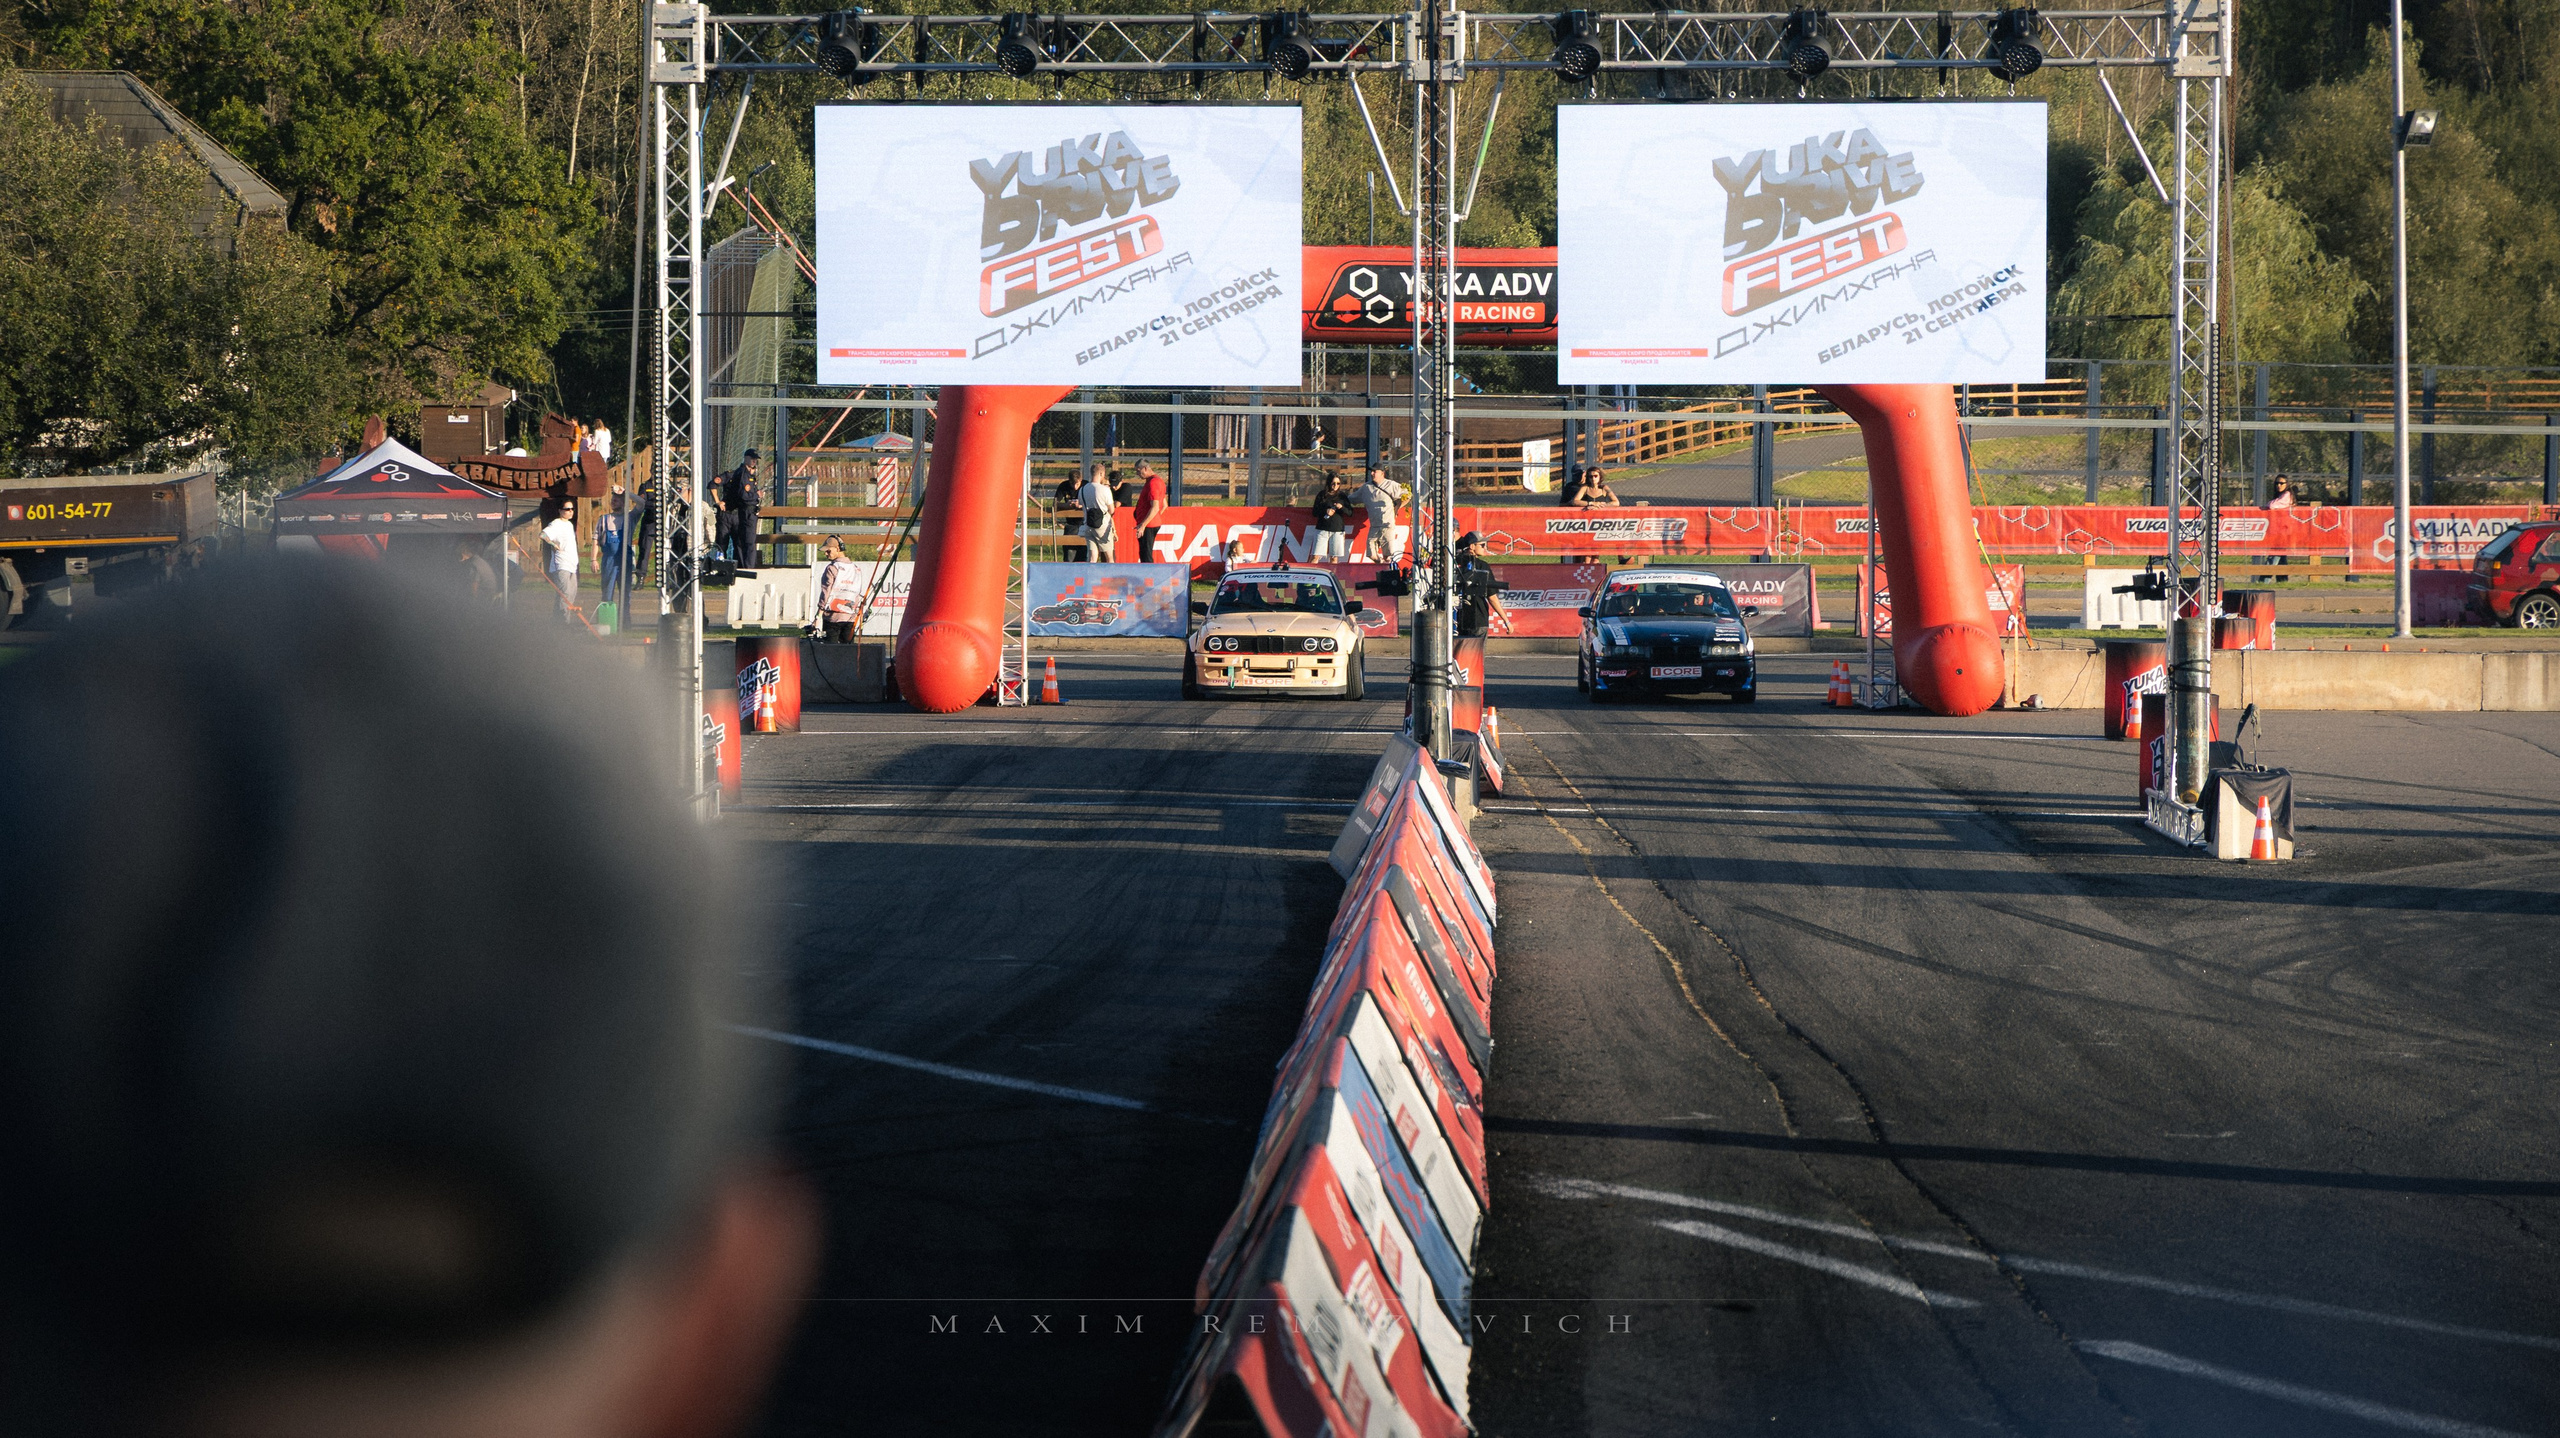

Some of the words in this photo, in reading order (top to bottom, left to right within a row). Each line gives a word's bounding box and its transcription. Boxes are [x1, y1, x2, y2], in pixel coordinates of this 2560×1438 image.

[969, 130, 1145, 198] YUKA
[1711, 127, 1889, 196] YUKA
[989, 217, 1151, 313] FEST
[1732, 215, 1894, 312] FEST
[1489, 272, 1553, 296] ADV
[1074, 315, 1183, 366] БЕЛАРУСЬ,
[1184, 267, 1280, 317] ЛОГОЙСК
[1158, 328, 1181, 347] 21
[1181, 284, 1284, 336] СЕНТЯБРЯ
[1460, 305, 1536, 320] RACING
[1817, 312, 1926, 364] БЕЛАРУСЬ,
[1927, 264, 2025, 315] ЛОГОЙСК
[1902, 327, 1923, 345] 21
[1926, 281, 2027, 334] СЕНТЯБРЯ
[26, 502, 113, 520] 601-54-77
[1546, 520, 1587, 532] YUKA
[1588, 520, 1638, 532] DRIVE
[1642, 519, 1686, 532] FEST
[2128, 520, 2167, 531] YUKA
[2223, 521, 2265, 531] FEST
[2419, 522, 2472, 537] YUKA
[2429, 543, 2456, 553] PRO
[2459, 543, 2483, 553] RAC
[1545, 591, 1587, 601] FEST
[1722, 580, 1750, 592] KA
[1751, 580, 1786, 592] ADV
[878, 598, 899, 606] PRO
[1737, 596, 1778, 605] RACING
[737, 658, 770, 688] YUKA
[740, 668, 779, 700] DRIVE
[2123, 665, 2163, 694] YUKA
[741, 687, 763, 712] FES
